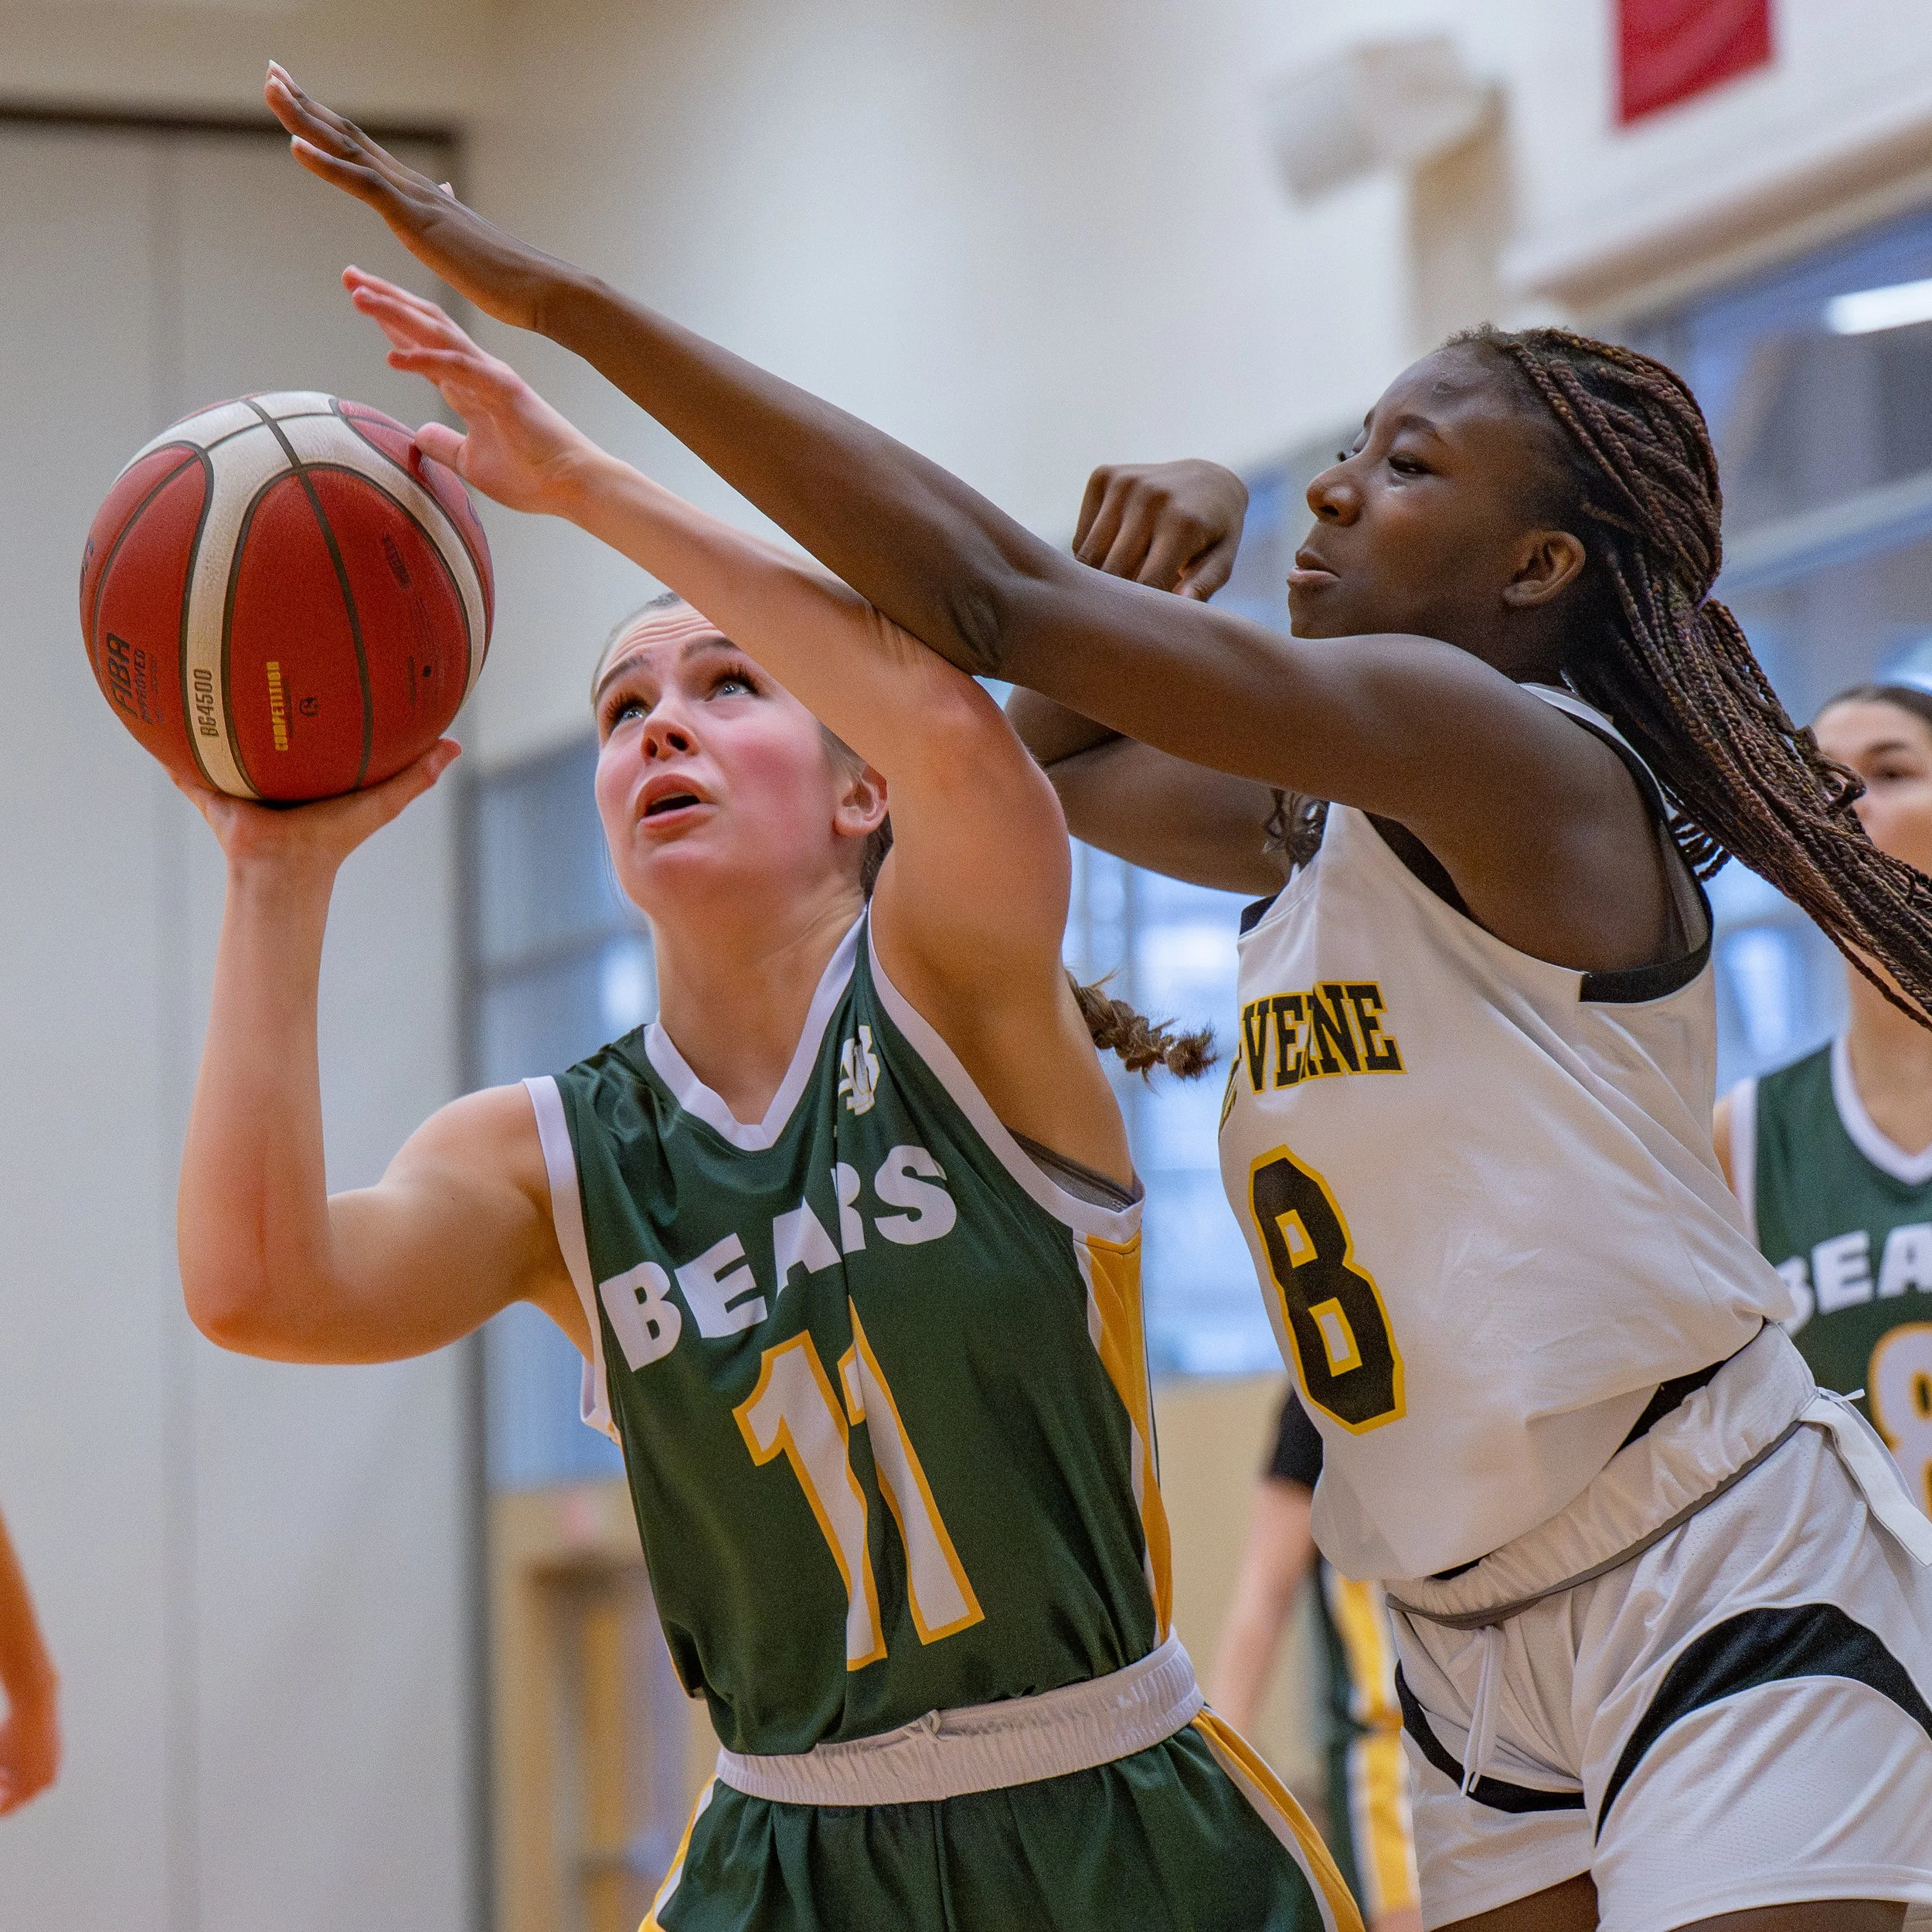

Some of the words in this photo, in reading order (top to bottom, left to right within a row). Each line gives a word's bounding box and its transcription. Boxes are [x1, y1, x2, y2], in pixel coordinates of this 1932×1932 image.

[107, 631, 138, 718] FIBA
[193, 668, 219, 737] BG4500
[266, 661, 289, 752] COMPETITION
[600, 1144, 957, 1372] BEARS
[1247, 1144, 1407, 1436] 8
[731, 1296, 985, 1672] 11
